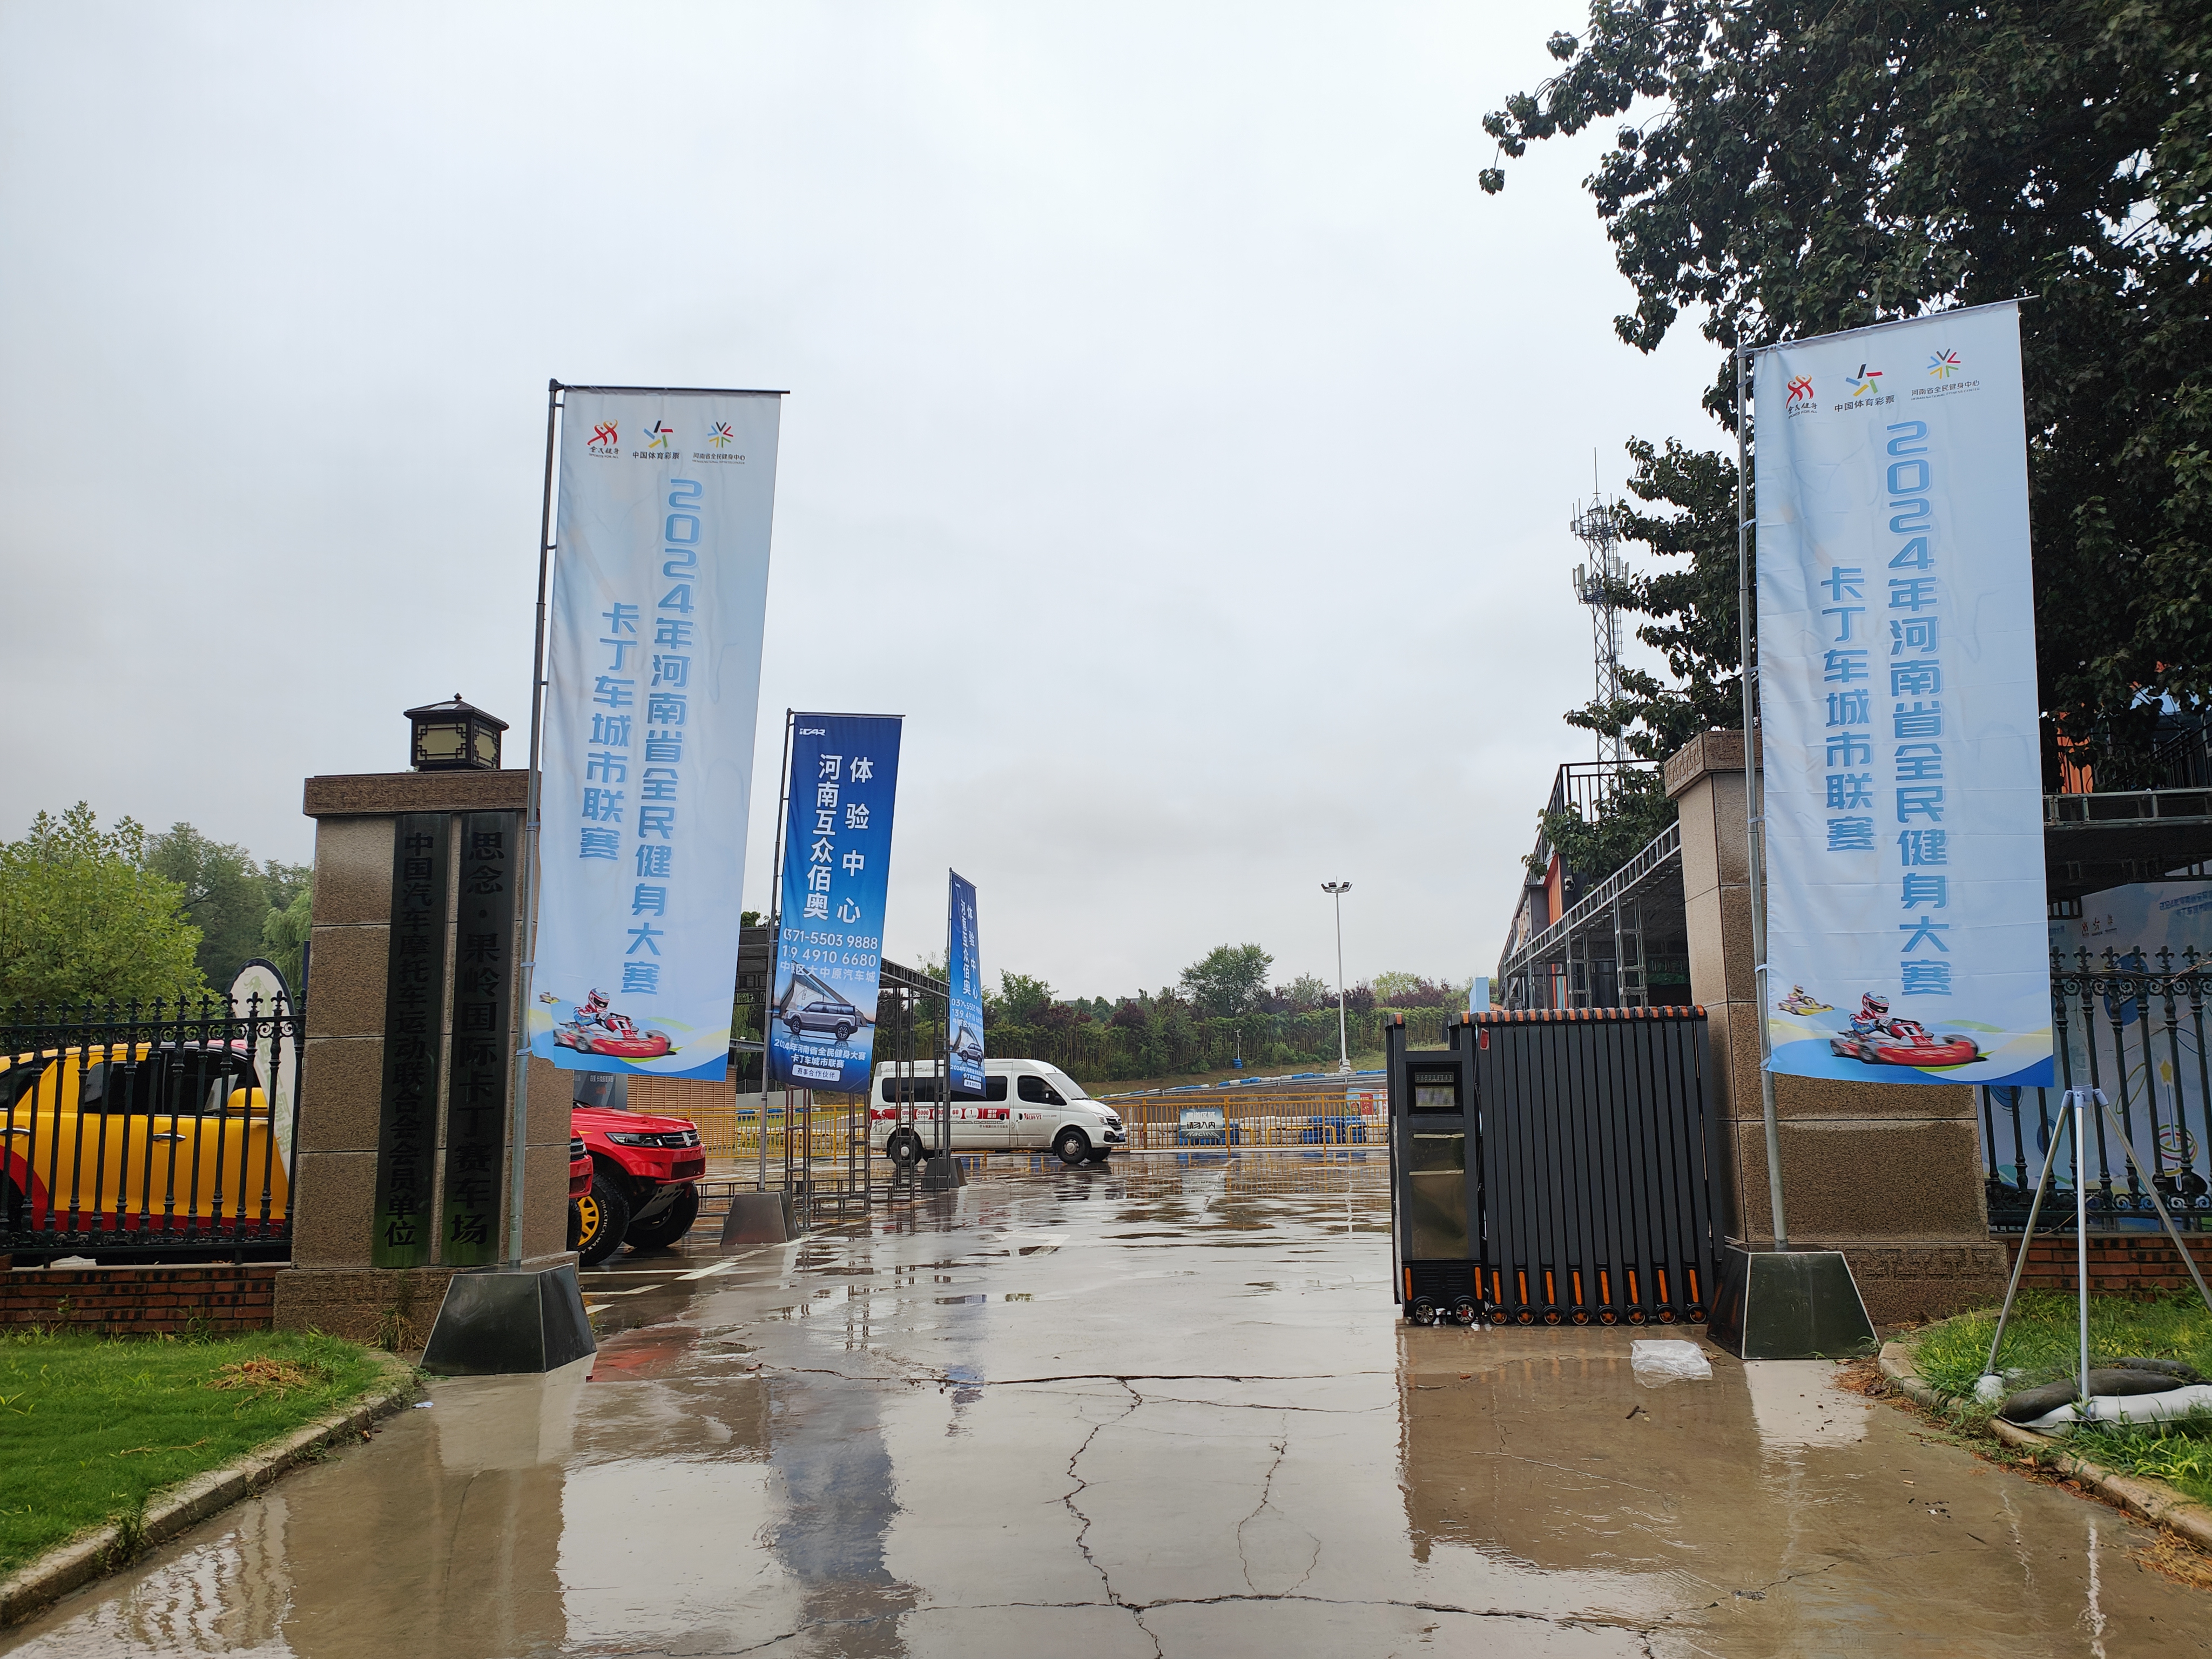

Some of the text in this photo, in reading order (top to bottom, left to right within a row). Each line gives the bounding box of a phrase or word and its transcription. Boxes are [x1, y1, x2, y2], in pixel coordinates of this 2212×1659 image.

[1911, 380, 1980, 396] 河南省全民健身中心
[1834, 394, 1895, 413] 中国体育彩票
[632, 451, 680, 460] 中国体育彩票
[693, 452, 745, 461] 河南省全民健身中心
[1820, 566, 1875, 852] 卡丁车城市联赛
[1886, 420, 1953, 996] 2024年河南省全民健身大赛
[579, 603, 639, 860] 卡丁车城市联赛
[621, 478, 704, 995] 2024年河南省全民健身大赛
[803, 754, 843, 920] 河南互众佰奥
[837, 756, 874, 925] 体验中心
[847, 935, 879, 950] 9888
[967, 905, 978, 1000] 体验中心
[802, 948, 838, 963] 4910
[842, 952, 877, 968] 6680
[384, 832, 434, 1248] 中国汽车摩托车运动联合会会员单位
[791, 1054, 845, 1069] 卡丁车城市联赛
[797, 1067, 835, 1078] 赛事合作伙伴
[1186, 1121, 1216, 1129] 请勿入内
